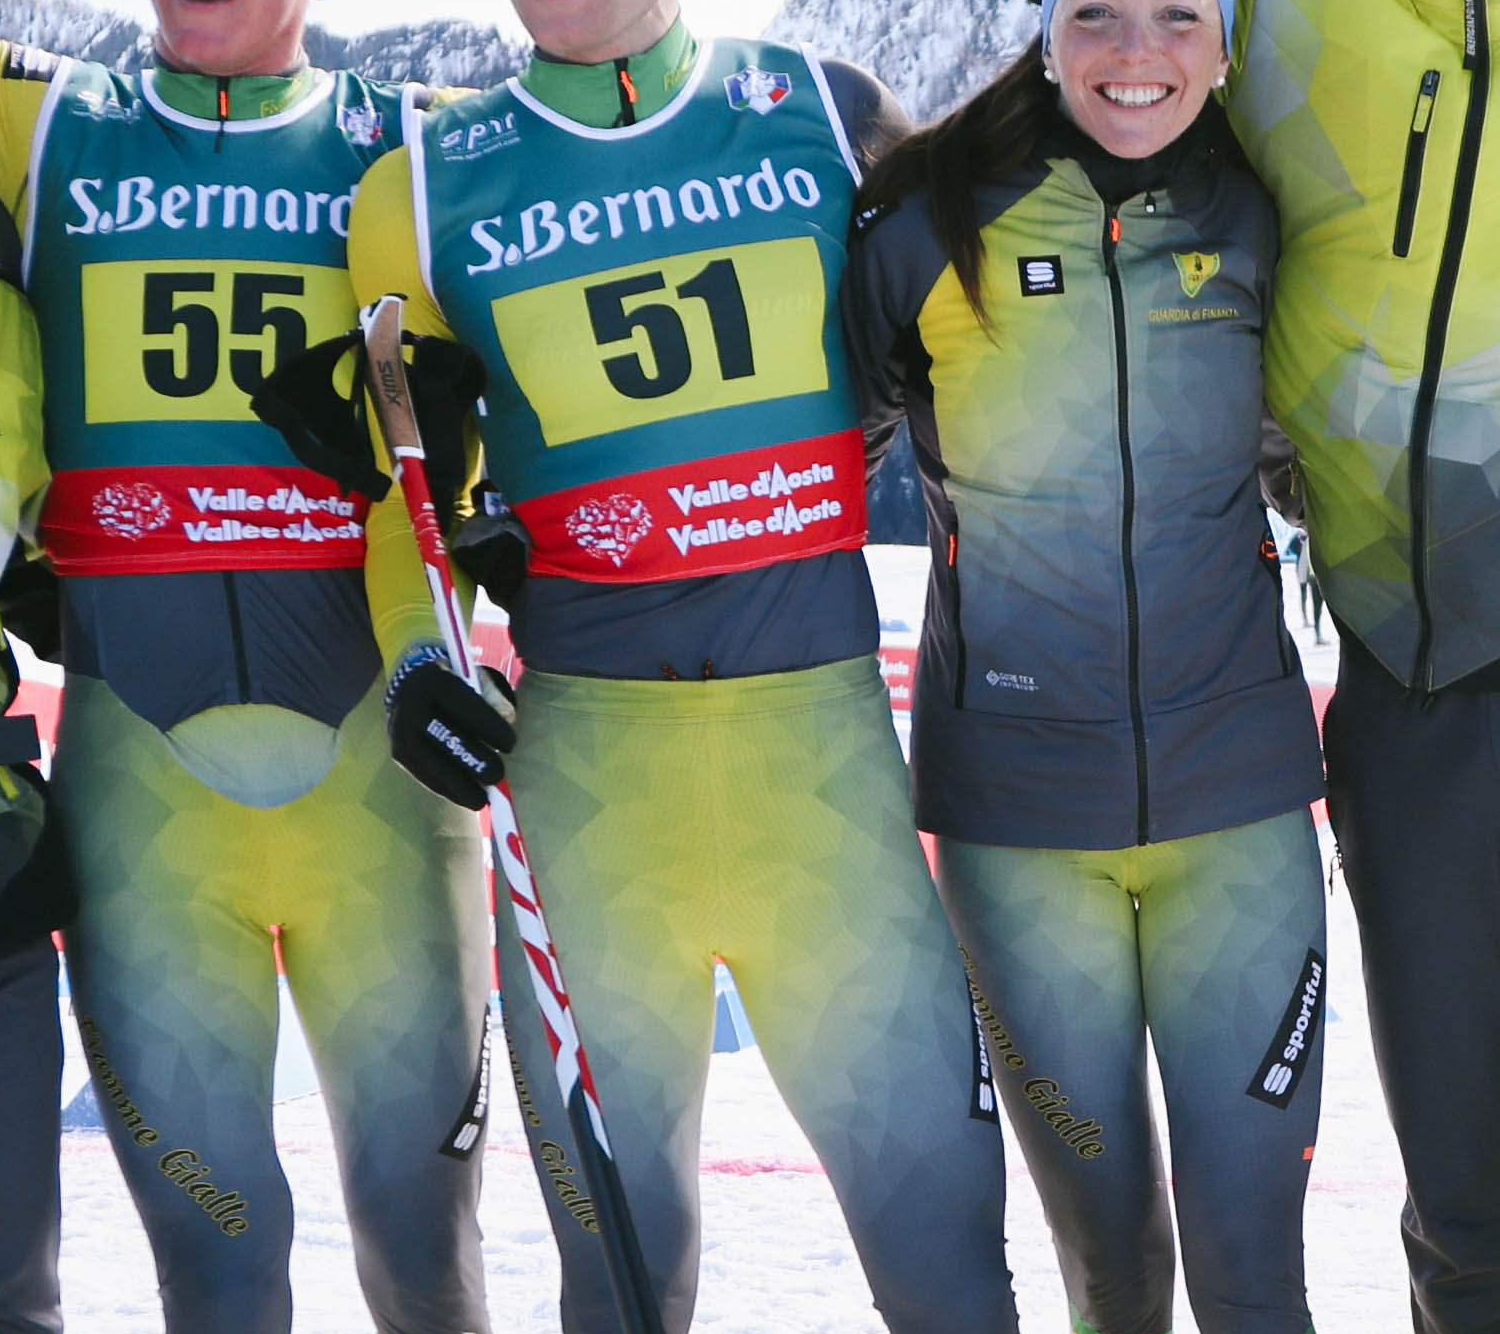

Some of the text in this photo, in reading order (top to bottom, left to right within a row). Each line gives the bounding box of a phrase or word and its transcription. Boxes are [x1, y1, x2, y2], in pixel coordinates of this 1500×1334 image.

[467, 158, 821, 276] S.Bernardo
[142, 272, 308, 398] 55
[584, 257, 756, 400] 51
[1148, 307, 1192, 323] GUARDIA
[182, 517, 280, 543] Vallée
[187, 486, 266, 517] Valle
[666, 498, 844, 557] Vallée d'Aoste
[667, 462, 837, 516] Valle d'Aosta
[1282, 961, 1323, 1062] sportful
[1025, 1076, 1106, 1161] Gialle
[158, 1148, 249, 1238] Gialle
